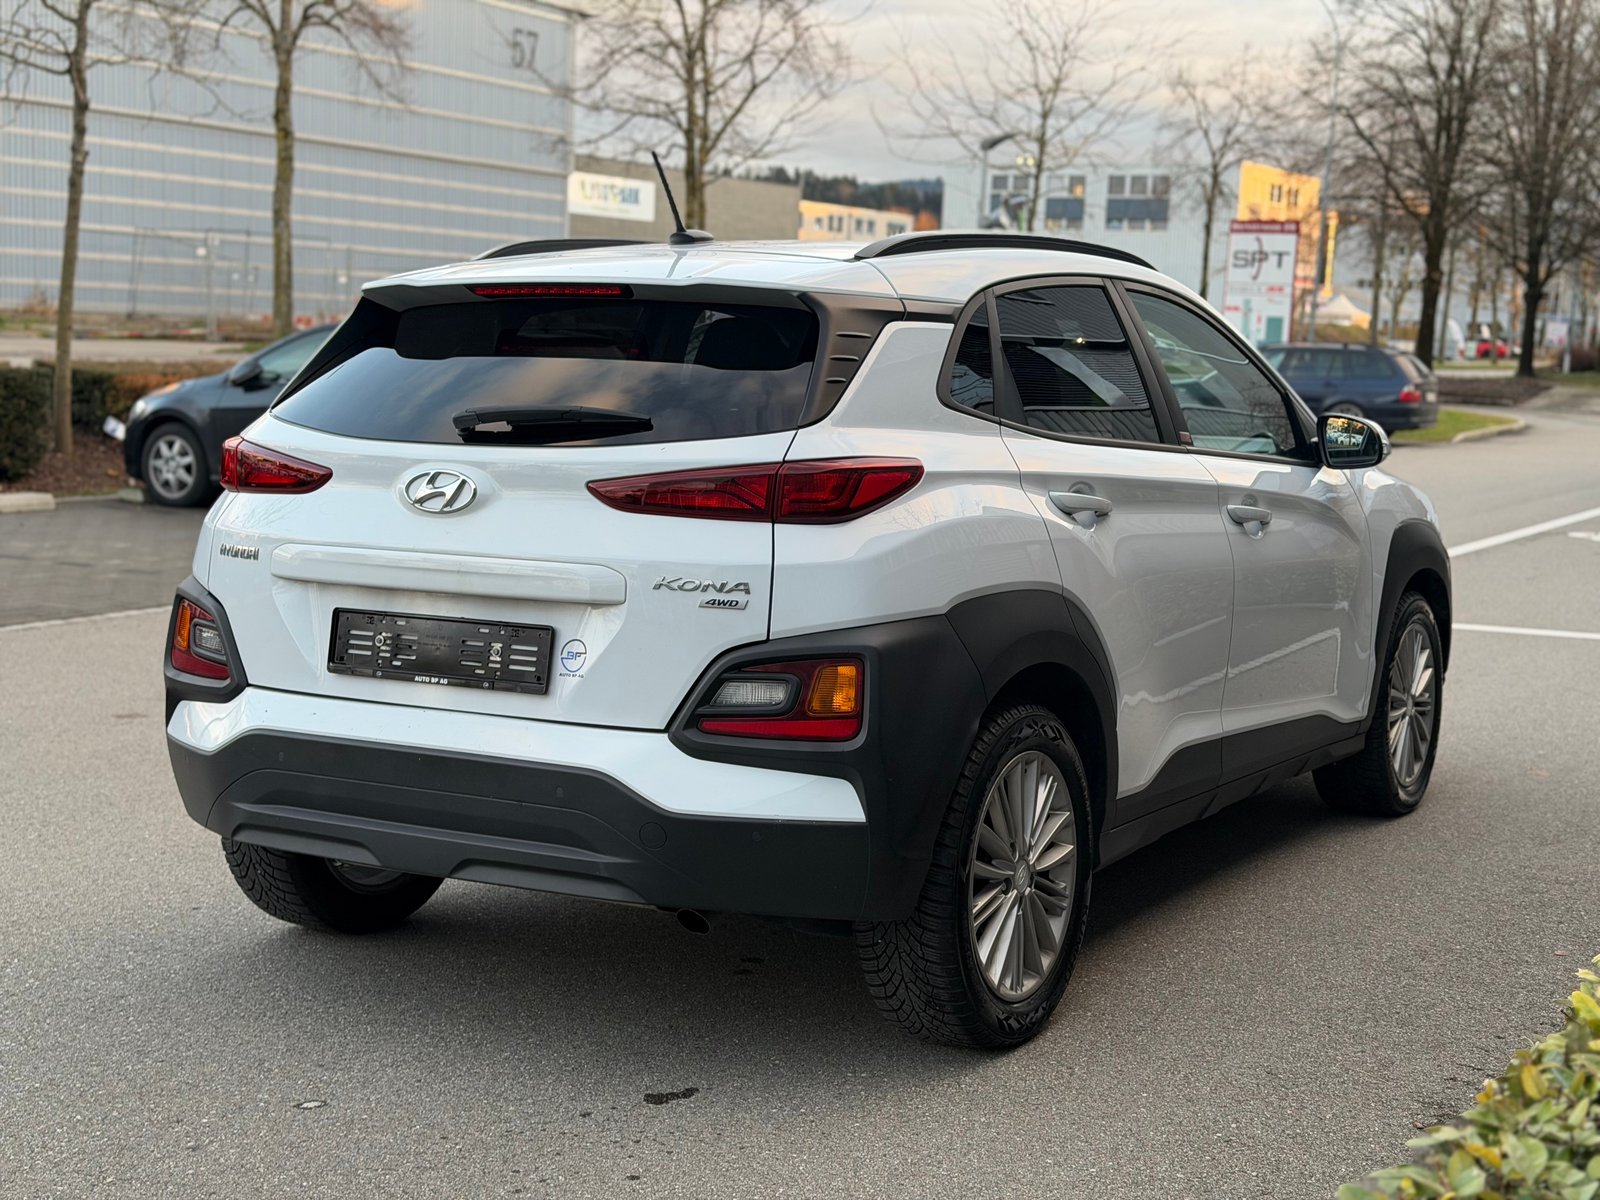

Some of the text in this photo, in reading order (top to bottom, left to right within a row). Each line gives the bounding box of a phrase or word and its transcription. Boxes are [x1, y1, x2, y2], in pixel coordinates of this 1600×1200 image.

[511, 28, 539, 68] 57
[219, 543, 260, 561] HYUNDAI
[652, 576, 751, 595] KONA
[704, 598, 740, 608] 4WD
[414, 675, 430, 683] AUTO
[430, 676, 439, 684] BP
